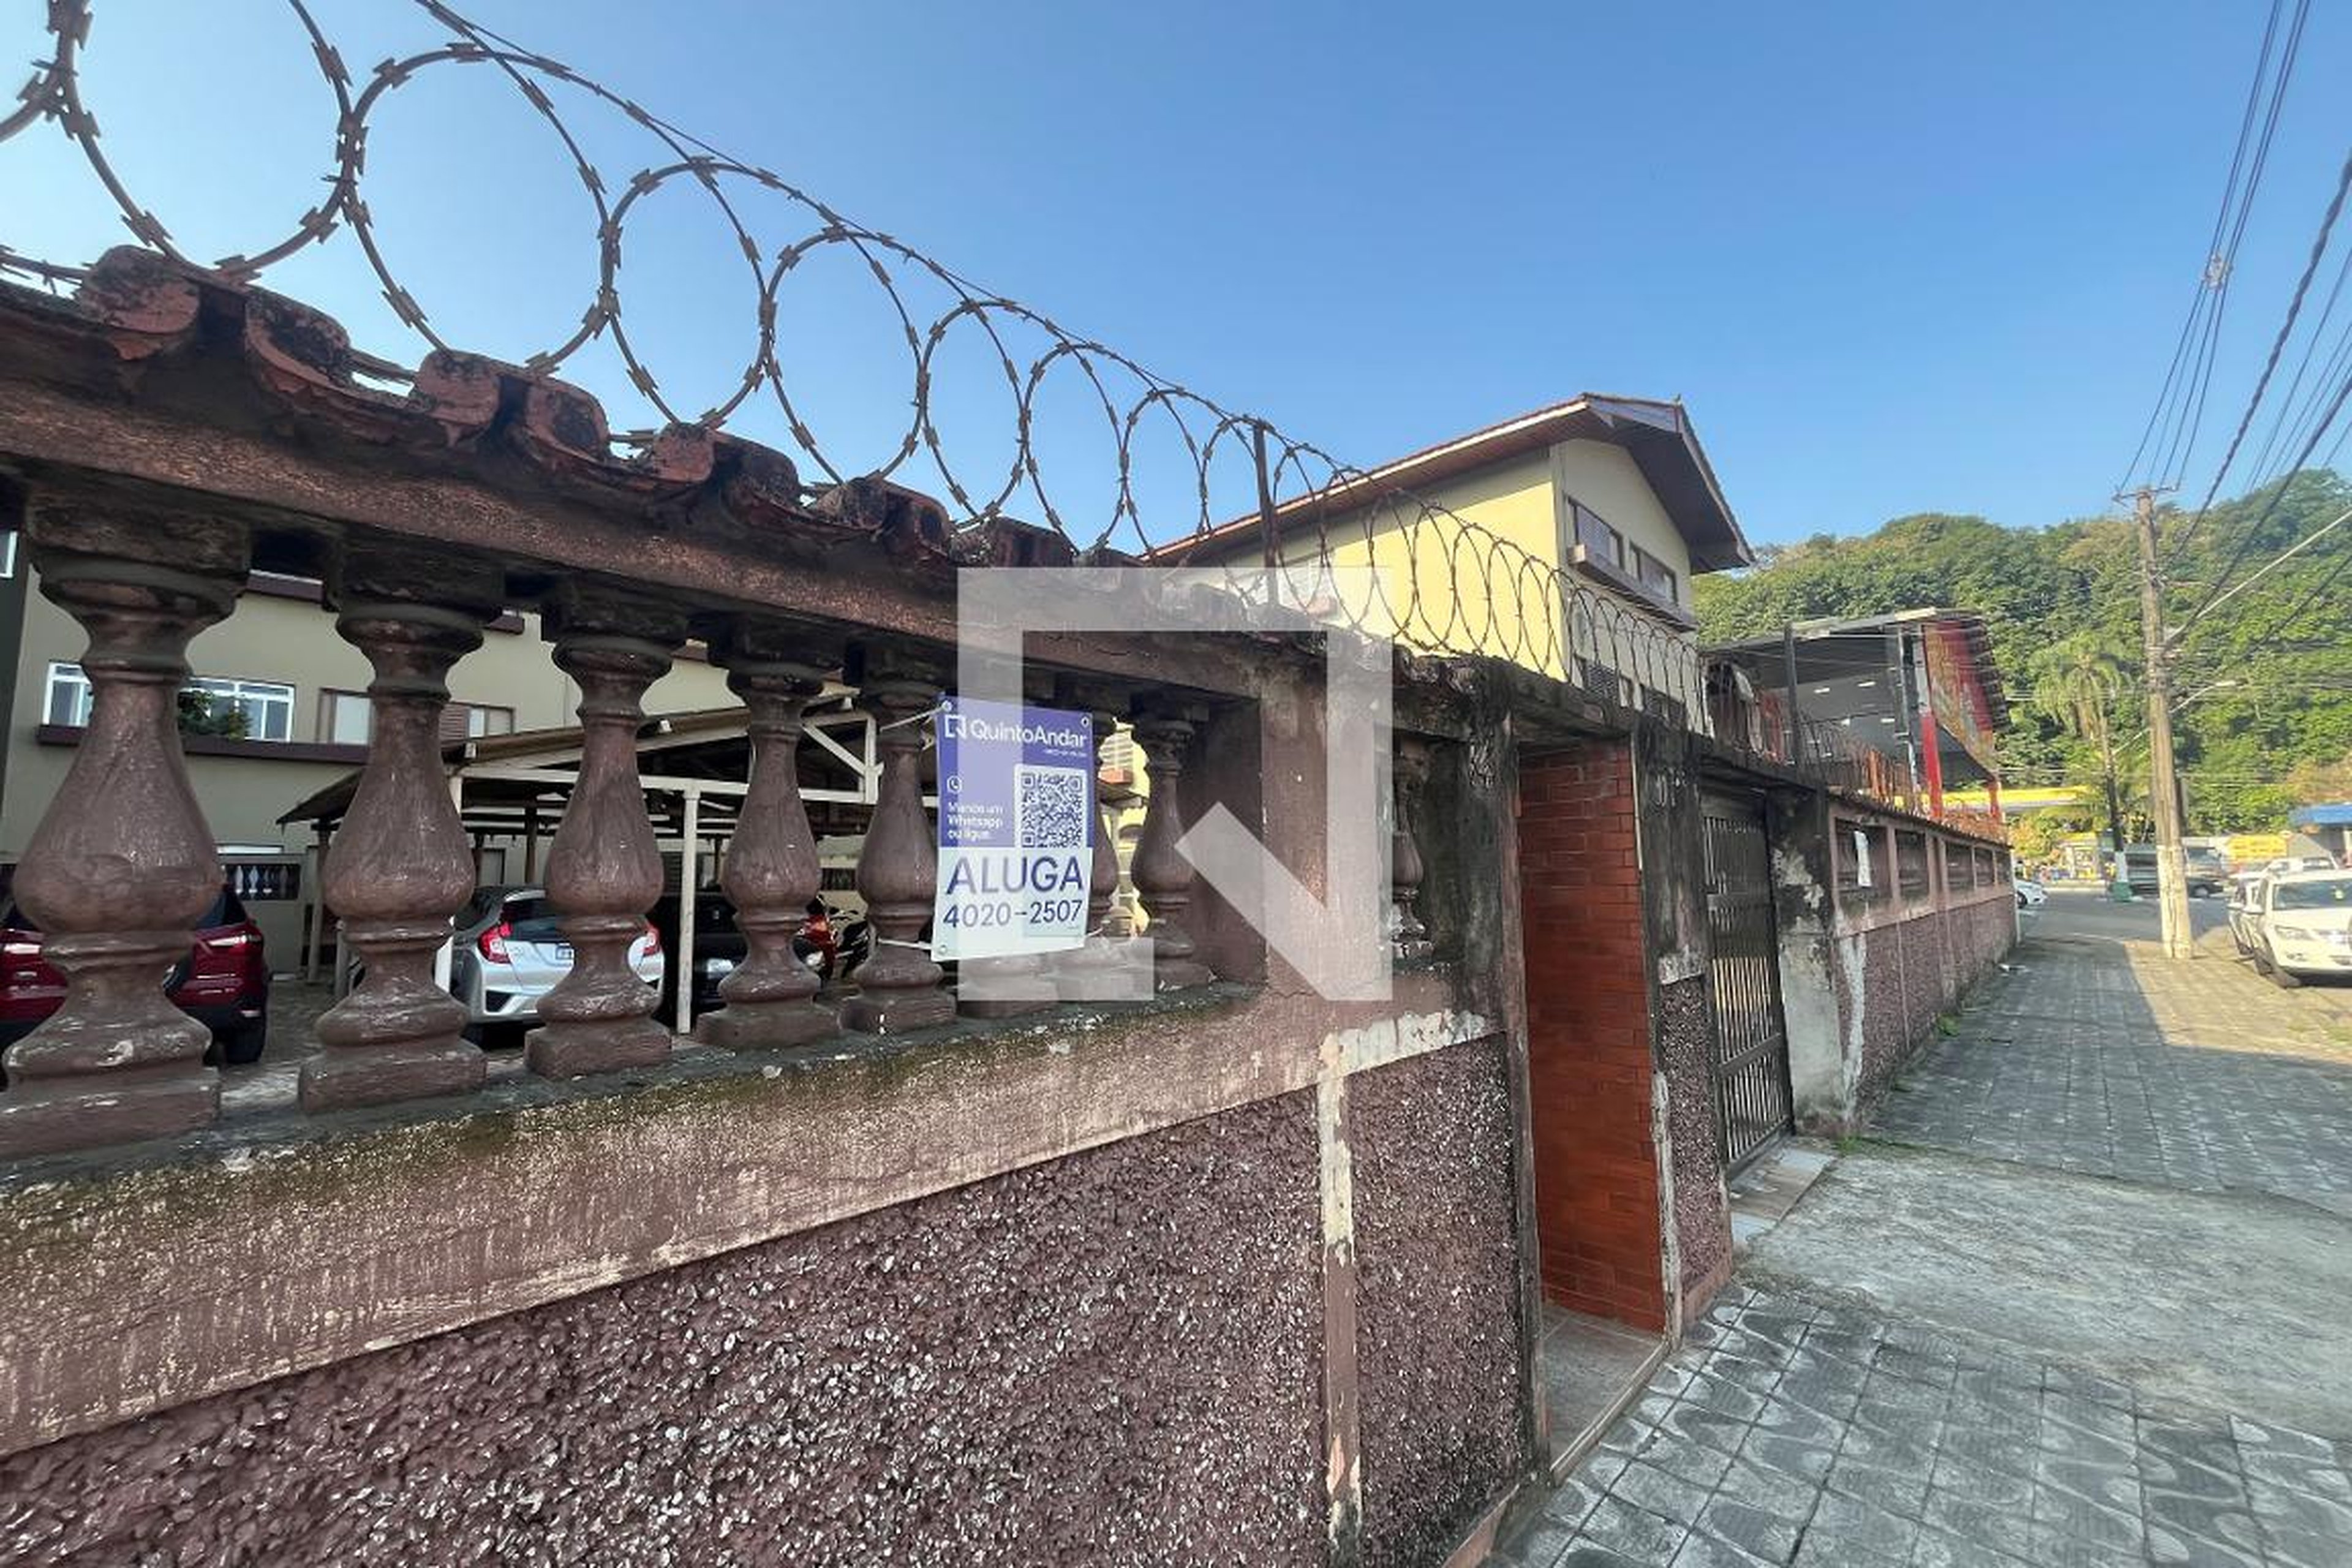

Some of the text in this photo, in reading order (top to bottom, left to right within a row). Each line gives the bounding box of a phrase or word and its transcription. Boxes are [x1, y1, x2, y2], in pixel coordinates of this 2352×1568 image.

[970, 718, 1087, 747] QuintoAndar
[946, 856, 1084, 894] ALUGA
[943, 900, 1083, 928] 4020-2507
